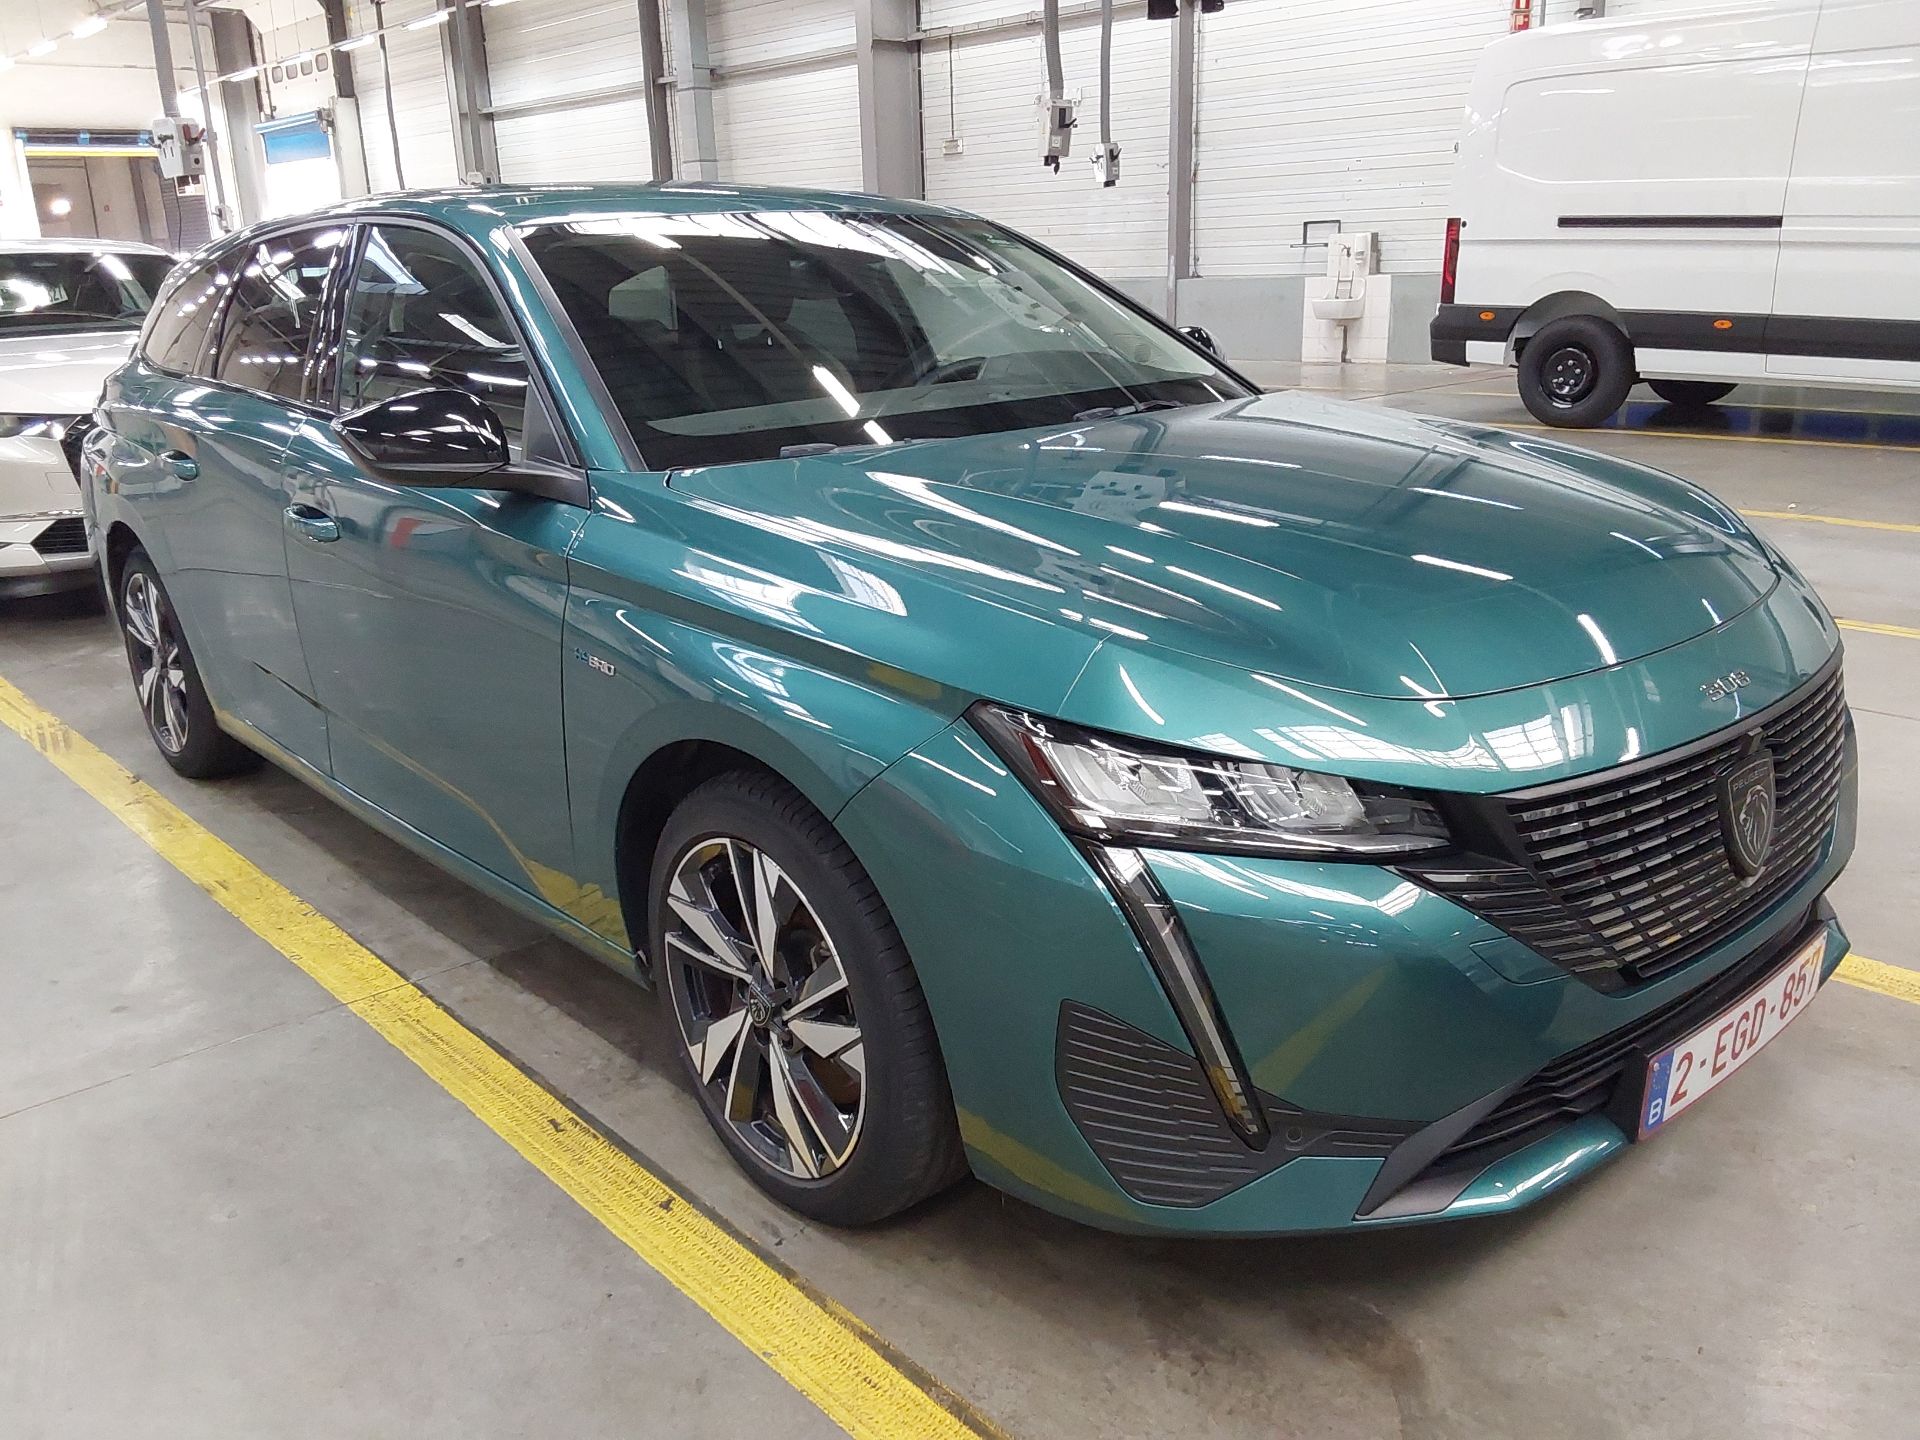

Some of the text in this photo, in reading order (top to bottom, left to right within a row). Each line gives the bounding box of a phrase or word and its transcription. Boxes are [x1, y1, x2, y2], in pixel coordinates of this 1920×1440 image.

[1700, 671, 1751, 702] 308
[1732, 766, 1769, 792] PEUGEOT
[1670, 945, 1823, 1107] 2-EGD-857
[1647, 1097, 1663, 1126] B
